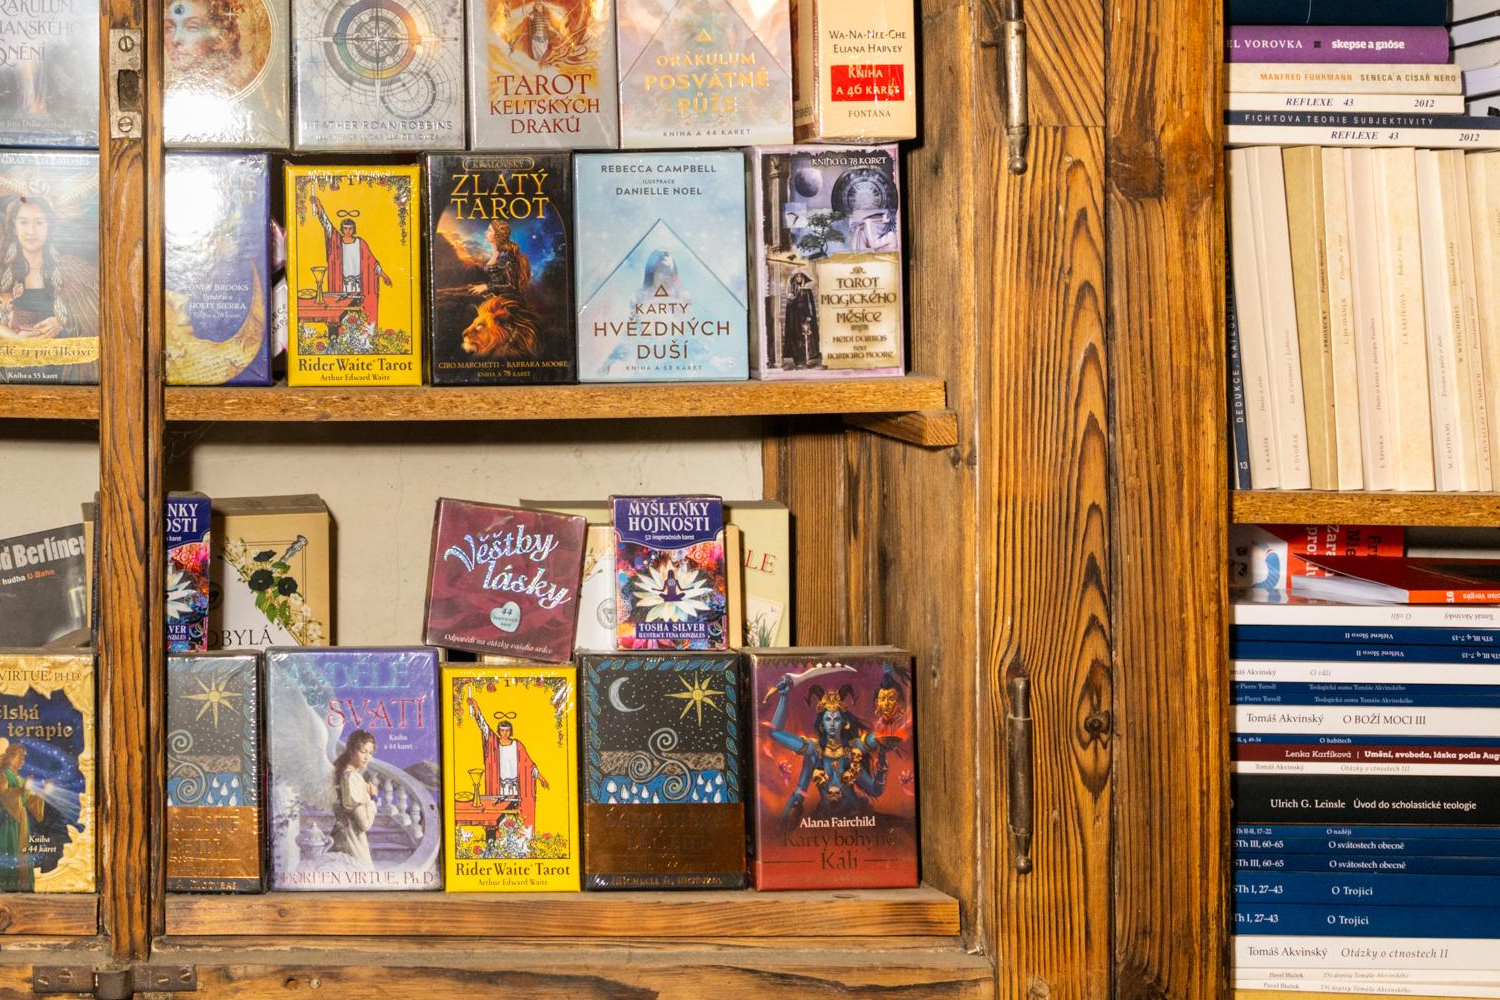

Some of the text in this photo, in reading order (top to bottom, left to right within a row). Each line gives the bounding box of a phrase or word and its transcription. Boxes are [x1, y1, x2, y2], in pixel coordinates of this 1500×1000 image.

[1244, 39, 1405, 51] VOROVKA skepse a gnóse
[1285, 98, 1435, 107] REFLEXE 43 2012
[847, 108, 892, 119] FONTÁNA
[600, 163, 717, 174] REBECCA CAMPBELL
[615, 186, 703, 196] DANIELLE NOEL
[635, 302, 690, 315] KARTY
[594, 316, 731, 338] HVĚZDNÝCH
[636, 339, 689, 360] DUŠÍ
[628, 500, 710, 517] MYŠLENKY
[628, 516, 710, 532] HOJNOSTI
[443, 524, 559, 573] Věštby
[482, 560, 572, 609] lásky
[639, 623, 705, 633] TOSHA SILVER
[6, 721, 74, 740] terapie
[1270, 799, 1346, 809] Ulrich G. Leinsle
[1353, 798, 1477, 812] Úvod do scholastické teologie
[799, 816, 876, 829] Alana Fairchild
[455, 861, 493, 877] Rider
[535, 862, 570, 876] Tarot
